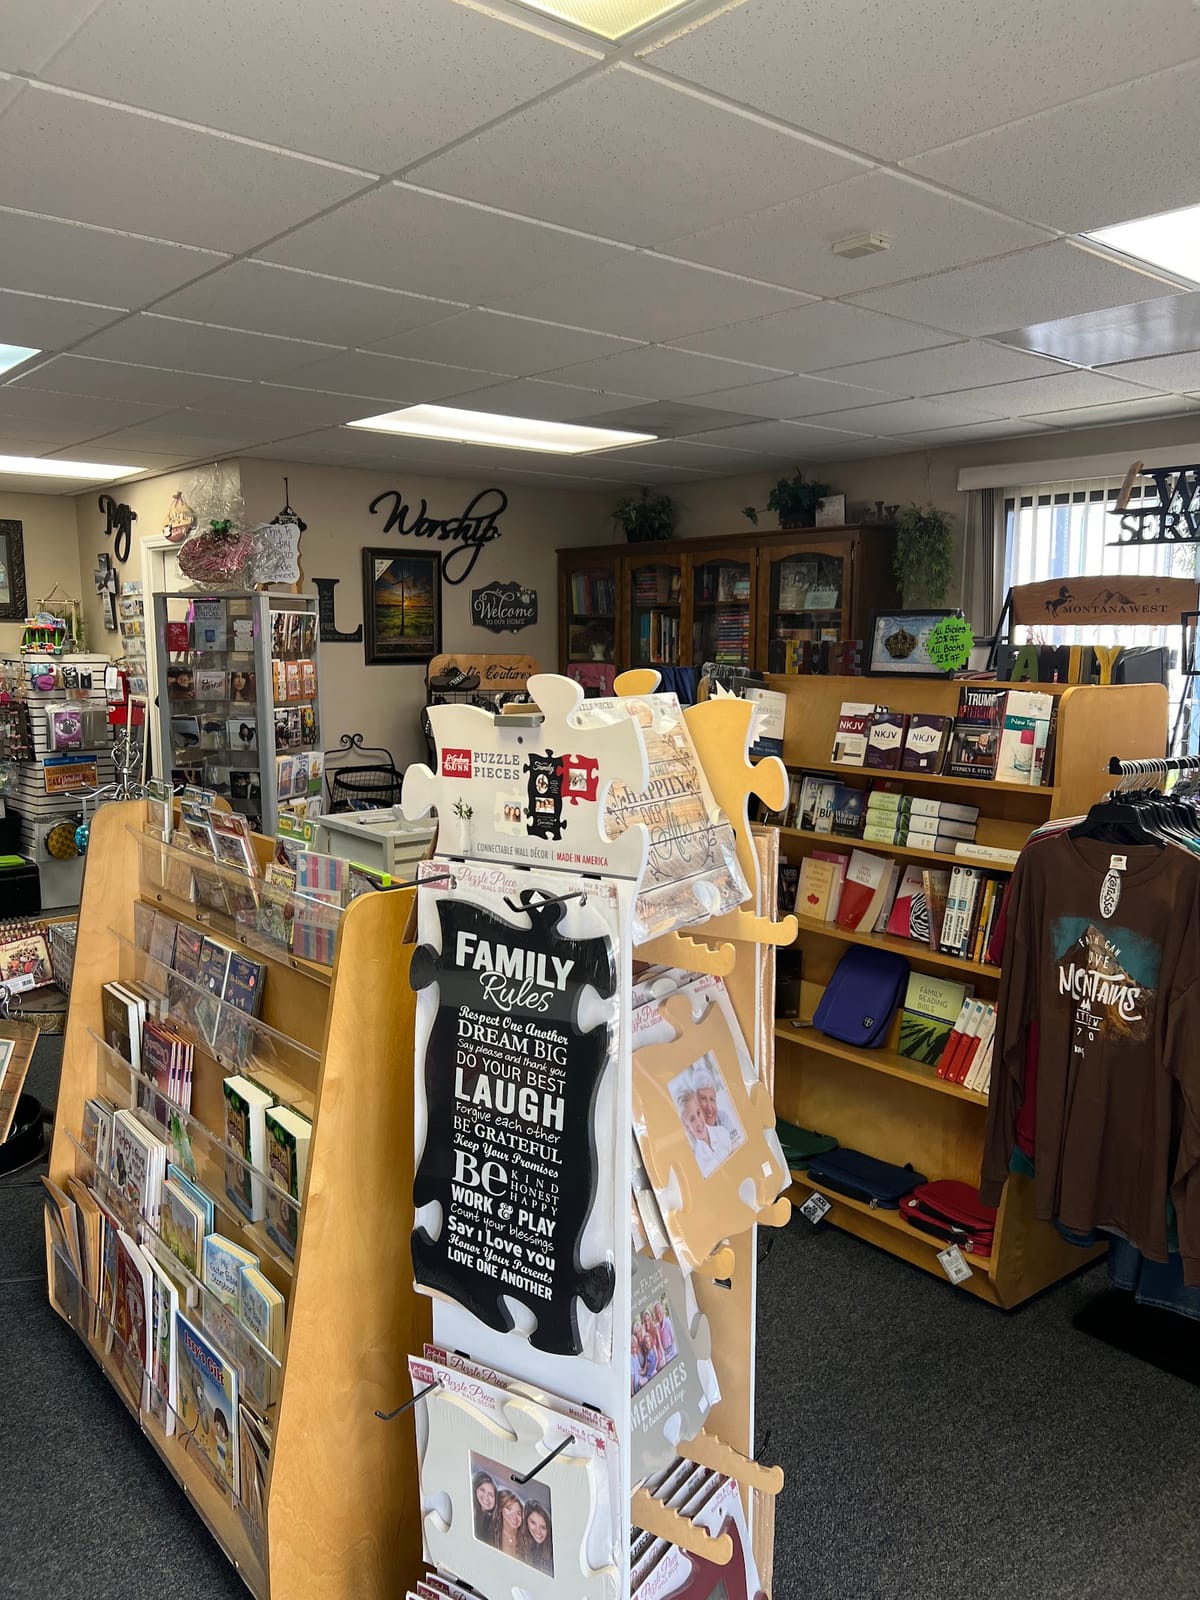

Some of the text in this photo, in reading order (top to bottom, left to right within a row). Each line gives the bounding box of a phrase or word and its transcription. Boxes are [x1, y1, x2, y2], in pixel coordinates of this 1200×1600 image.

[369, 488, 508, 585] Worship
[474, 590, 534, 619] Welcome
[1062, 605, 1168, 613] MONTANA WEST
[944, 644, 965, 653] Books
[840, 720, 864, 731] NKJV
[873, 730, 898, 740] NKJV
[1010, 718, 1025, 726] New
[912, 733, 937, 743] NKJV
[474, 752, 520, 766] PUZZLE
[474, 767, 520, 780] PIECES
[641, 803, 665, 825] EVER
[477, 843, 514, 856] CONNECTABLE
[515, 846, 529, 858] WALL
[556, 851, 574, 862] MADE
[575, 853, 581, 863] IN
[582, 854, 609, 867] AMERICA
[457, 866, 489, 887] Puzzle
[455, 930, 575, 991] FAMILY
[479, 970, 554, 1012] Rules
[917, 994, 948, 1009] READING
[919, 986, 944, 999] FAMILY
[459, 1005, 569, 1045] Respect One Another
[457, 1019, 568, 1066] DREAM BIG
[457, 1038, 475, 1052] Say
[475, 1044, 503, 1060] please
[504, 1049, 522, 1064] and
[549, 1065, 567, 1078] you
[456, 1051, 567, 1095] DO YOUR BEST
[454, 1067, 565, 1132] LAUGH
[456, 1102, 561, 1145] Forgive each other
[454, 1115, 563, 1166] BE GRATEFUL
[454, 1132, 559, 1179] Keep Your Promises
[451, 1149, 559, 1197] Be KIND
[510, 1180, 559, 1206] HONEST
[510, 1191, 559, 1217] HAPPY
[451, 1183, 557, 1238] WORK & PLAY
[450, 1202, 555, 1253] Count your blessings
[477, 1229, 483, 1242] I
[448, 1233, 553, 1284] Honor Your Parents
[447, 1246, 553, 1301] LOVE ONE ANOTHER
[206, 1353, 225, 1387] Gift
[437, 1369, 467, 1393] Puzzle
[450, 1356, 480, 1378] Puzzle
[631, 1361, 687, 1432] MEMORIES
